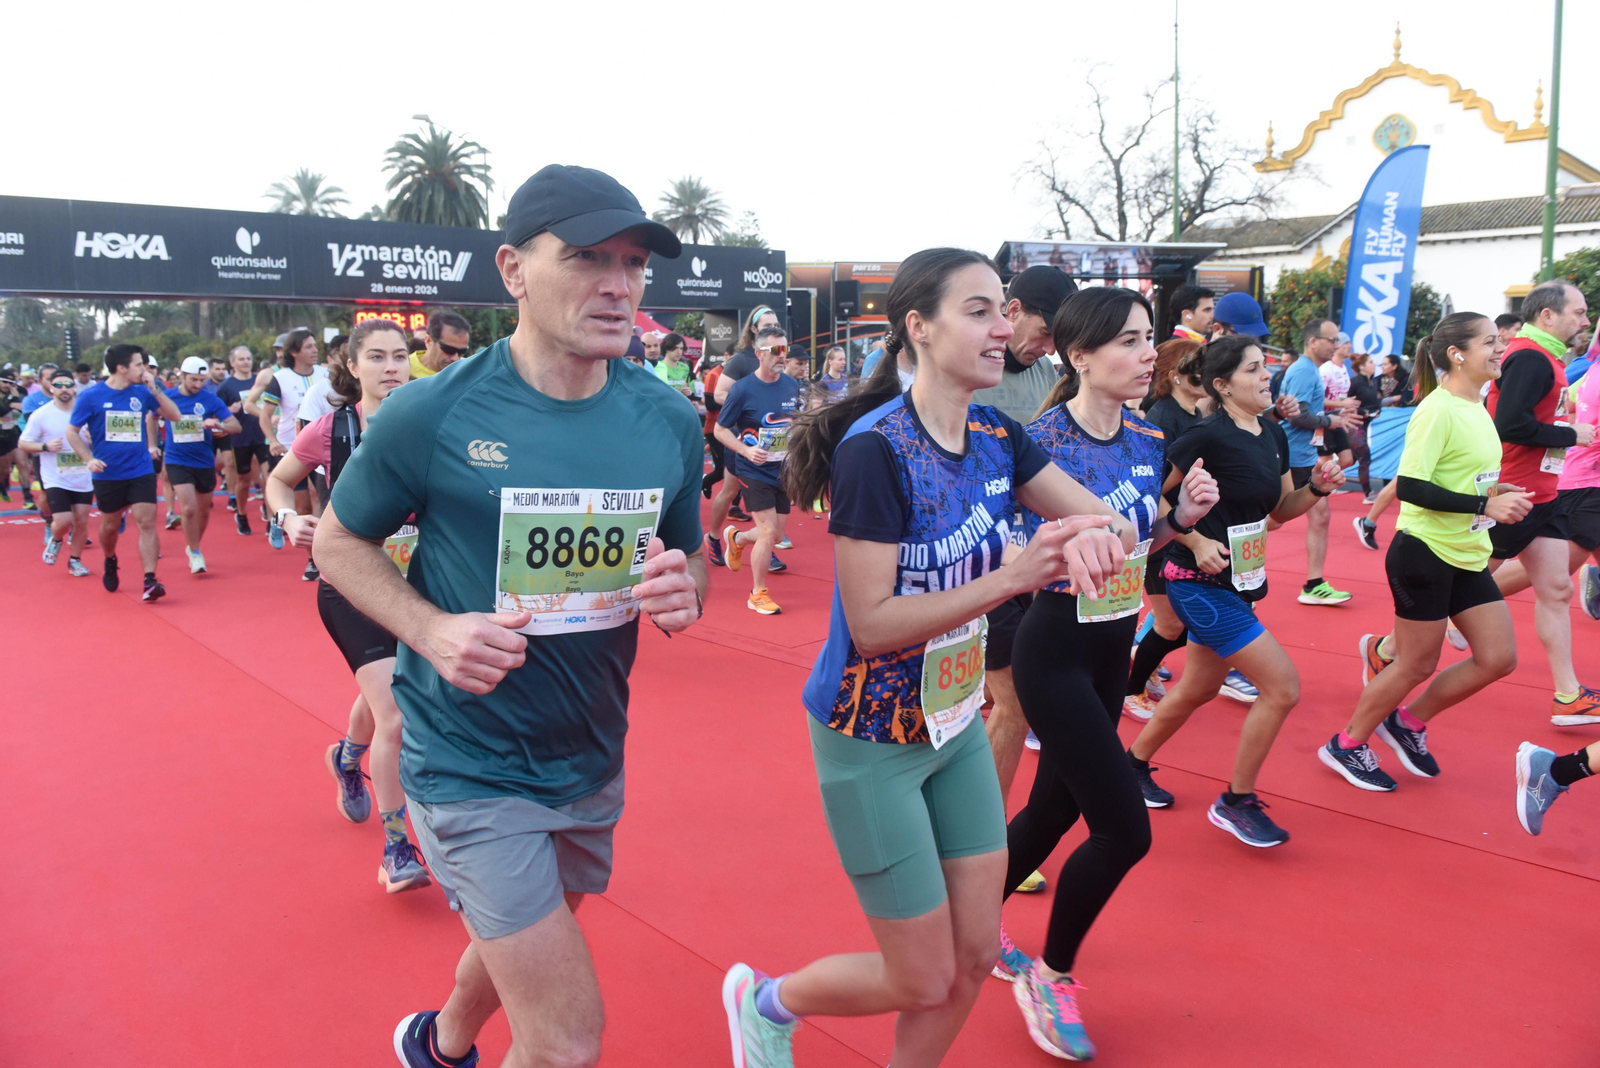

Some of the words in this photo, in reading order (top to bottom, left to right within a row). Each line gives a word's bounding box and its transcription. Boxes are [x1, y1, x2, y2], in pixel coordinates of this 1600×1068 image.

[1377, 191, 1399, 257] HUMAN
[74, 231, 170, 260] HOKA
[1364, 227, 1379, 256] FLY
[1391, 229, 1407, 257] FLY
[211, 254, 288, 270] quirónsalud
[355, 244, 452, 265] maratón
[218, 270, 255, 280] Healthcare
[256, 272, 282, 281] Partner
[677, 278, 723, 289] quirónsalud
[370, 283, 383, 293] 28
[385, 284, 413, 294] enero
[414, 285, 438, 295] 2024
[1352, 260, 1404, 366] OKA
[112, 419, 135, 428] 6044
[175, 421, 196, 430] 6045
[466, 460, 510, 471] canterbury
[984, 476, 1010, 497] HOK
[1102, 479, 1142, 513] RATÓN
[512, 492, 539, 506] MEDIO
[542, 490, 580, 507] MARATÓN
[602, 491, 644, 510] SEVILLA
[897, 542, 929, 570] DIO
[934, 501, 995, 568] MARATÓN
[386, 542, 411, 564] 76
[526, 526, 625, 569] 8868
[1242, 536, 1266, 561] 858
[565, 570, 584, 581] Bayo
[564, 615, 587, 624] HOKA
